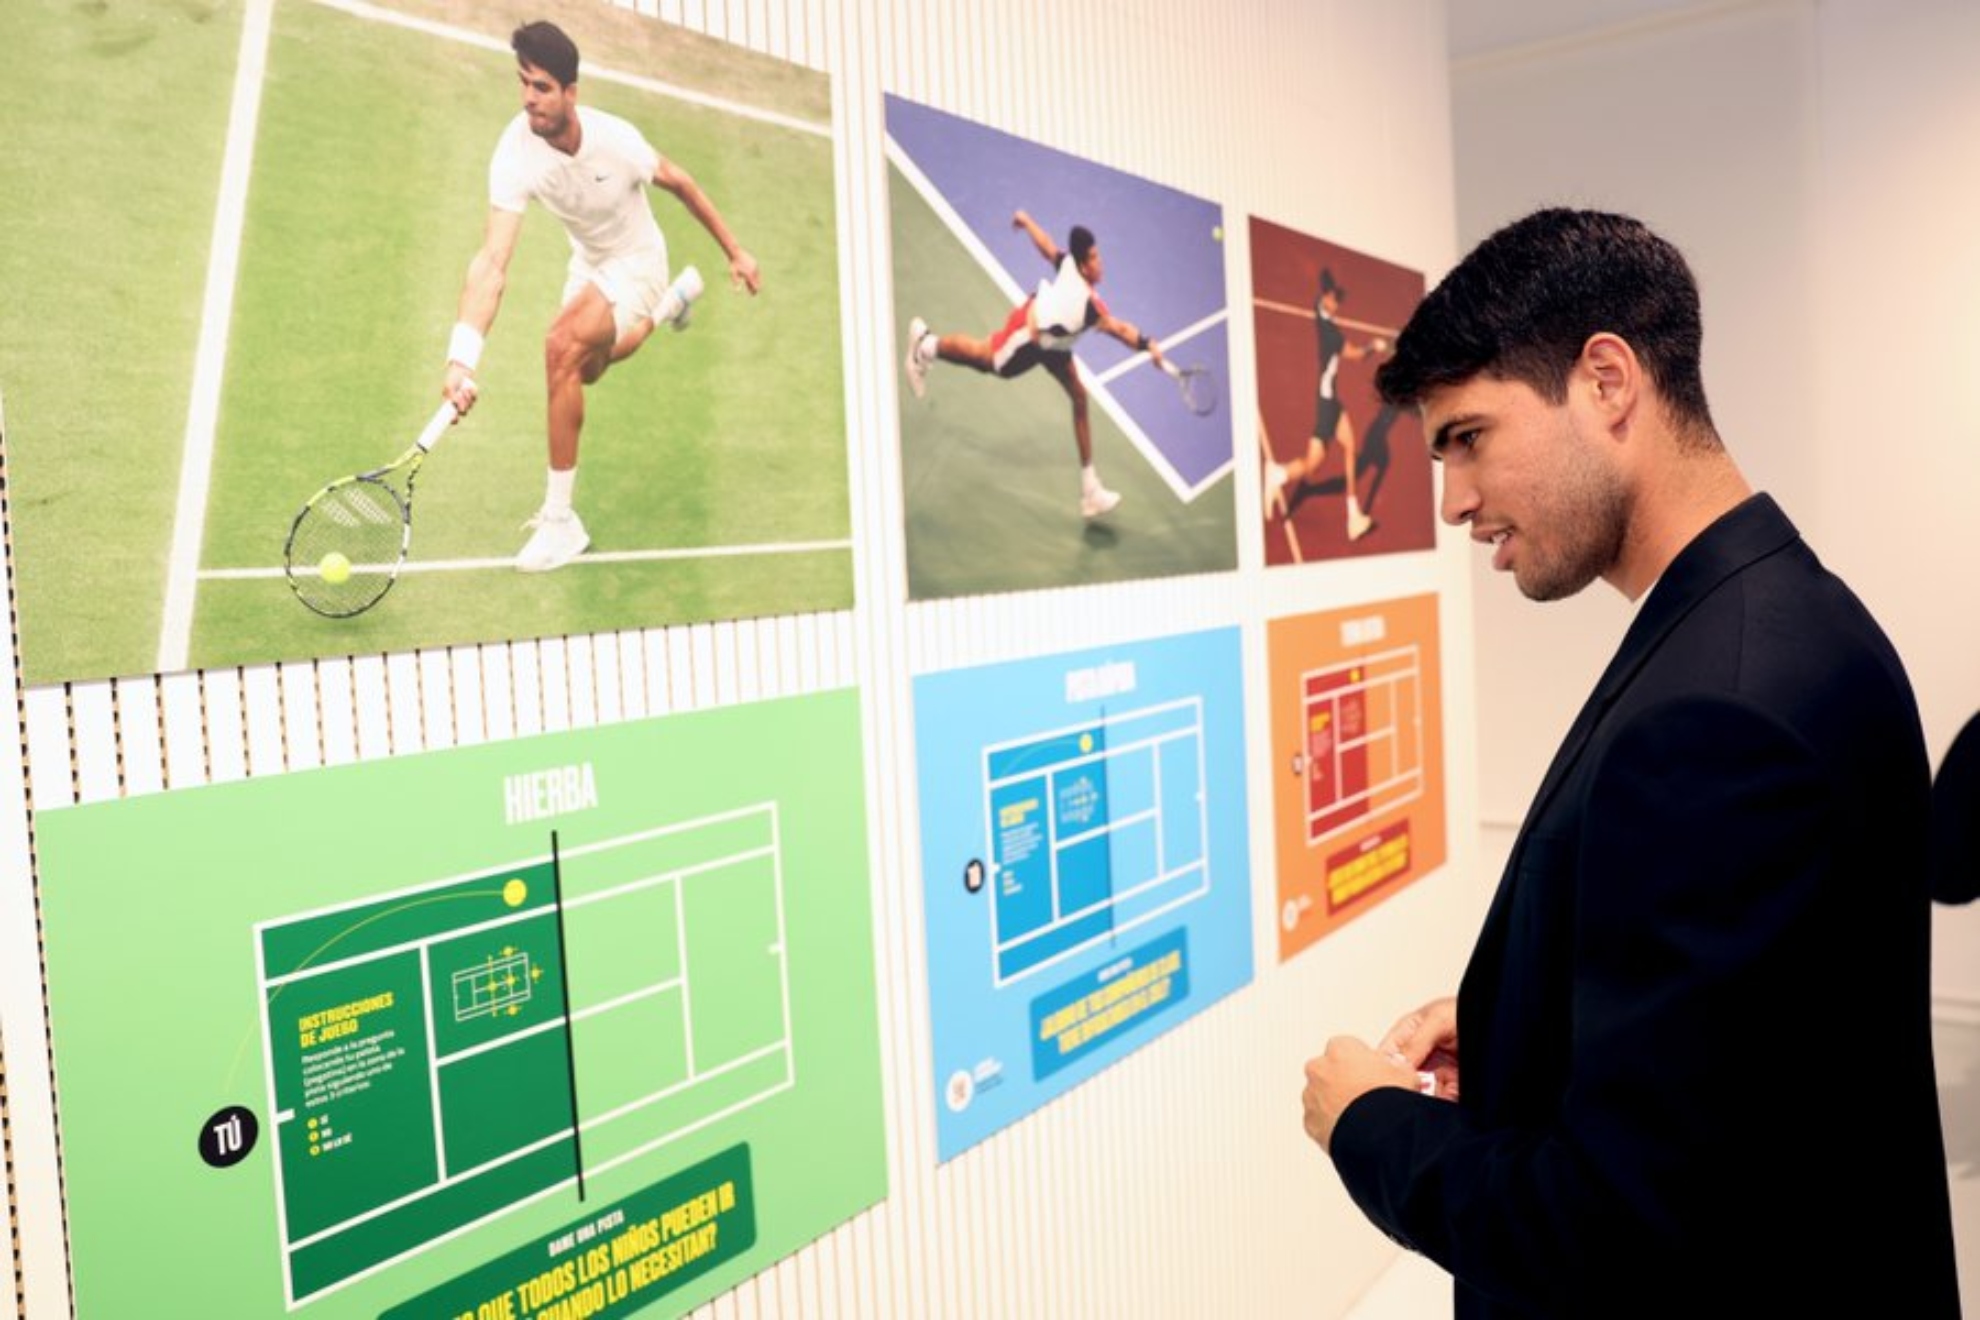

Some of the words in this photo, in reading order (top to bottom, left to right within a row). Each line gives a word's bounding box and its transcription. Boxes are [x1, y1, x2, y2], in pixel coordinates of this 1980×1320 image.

[504, 762, 598, 825] HIERBA
[299, 991, 394, 1033] INSTRUCCIONES
[300, 1031, 318, 1049] DE
[319, 1018, 359, 1043] JUEGO
[213, 1113, 243, 1156] TÚ
[478, 1291, 517, 1320] QUE
[516, 1261, 576, 1315] TODOS
[577, 1243, 611, 1285] LOS
[611, 1218, 661, 1267] NIÑOS
[660, 1189, 719, 1242] PUEDEN
[718, 1180, 736, 1213] IR
[548, 1231, 575, 1258] DAME
[576, 1222, 597, 1244] UNA
[597, 1208, 624, 1235] PISTA
[606, 1268, 628, 1304] LO
[629, 1221, 718, 1293] NECESITAN?
